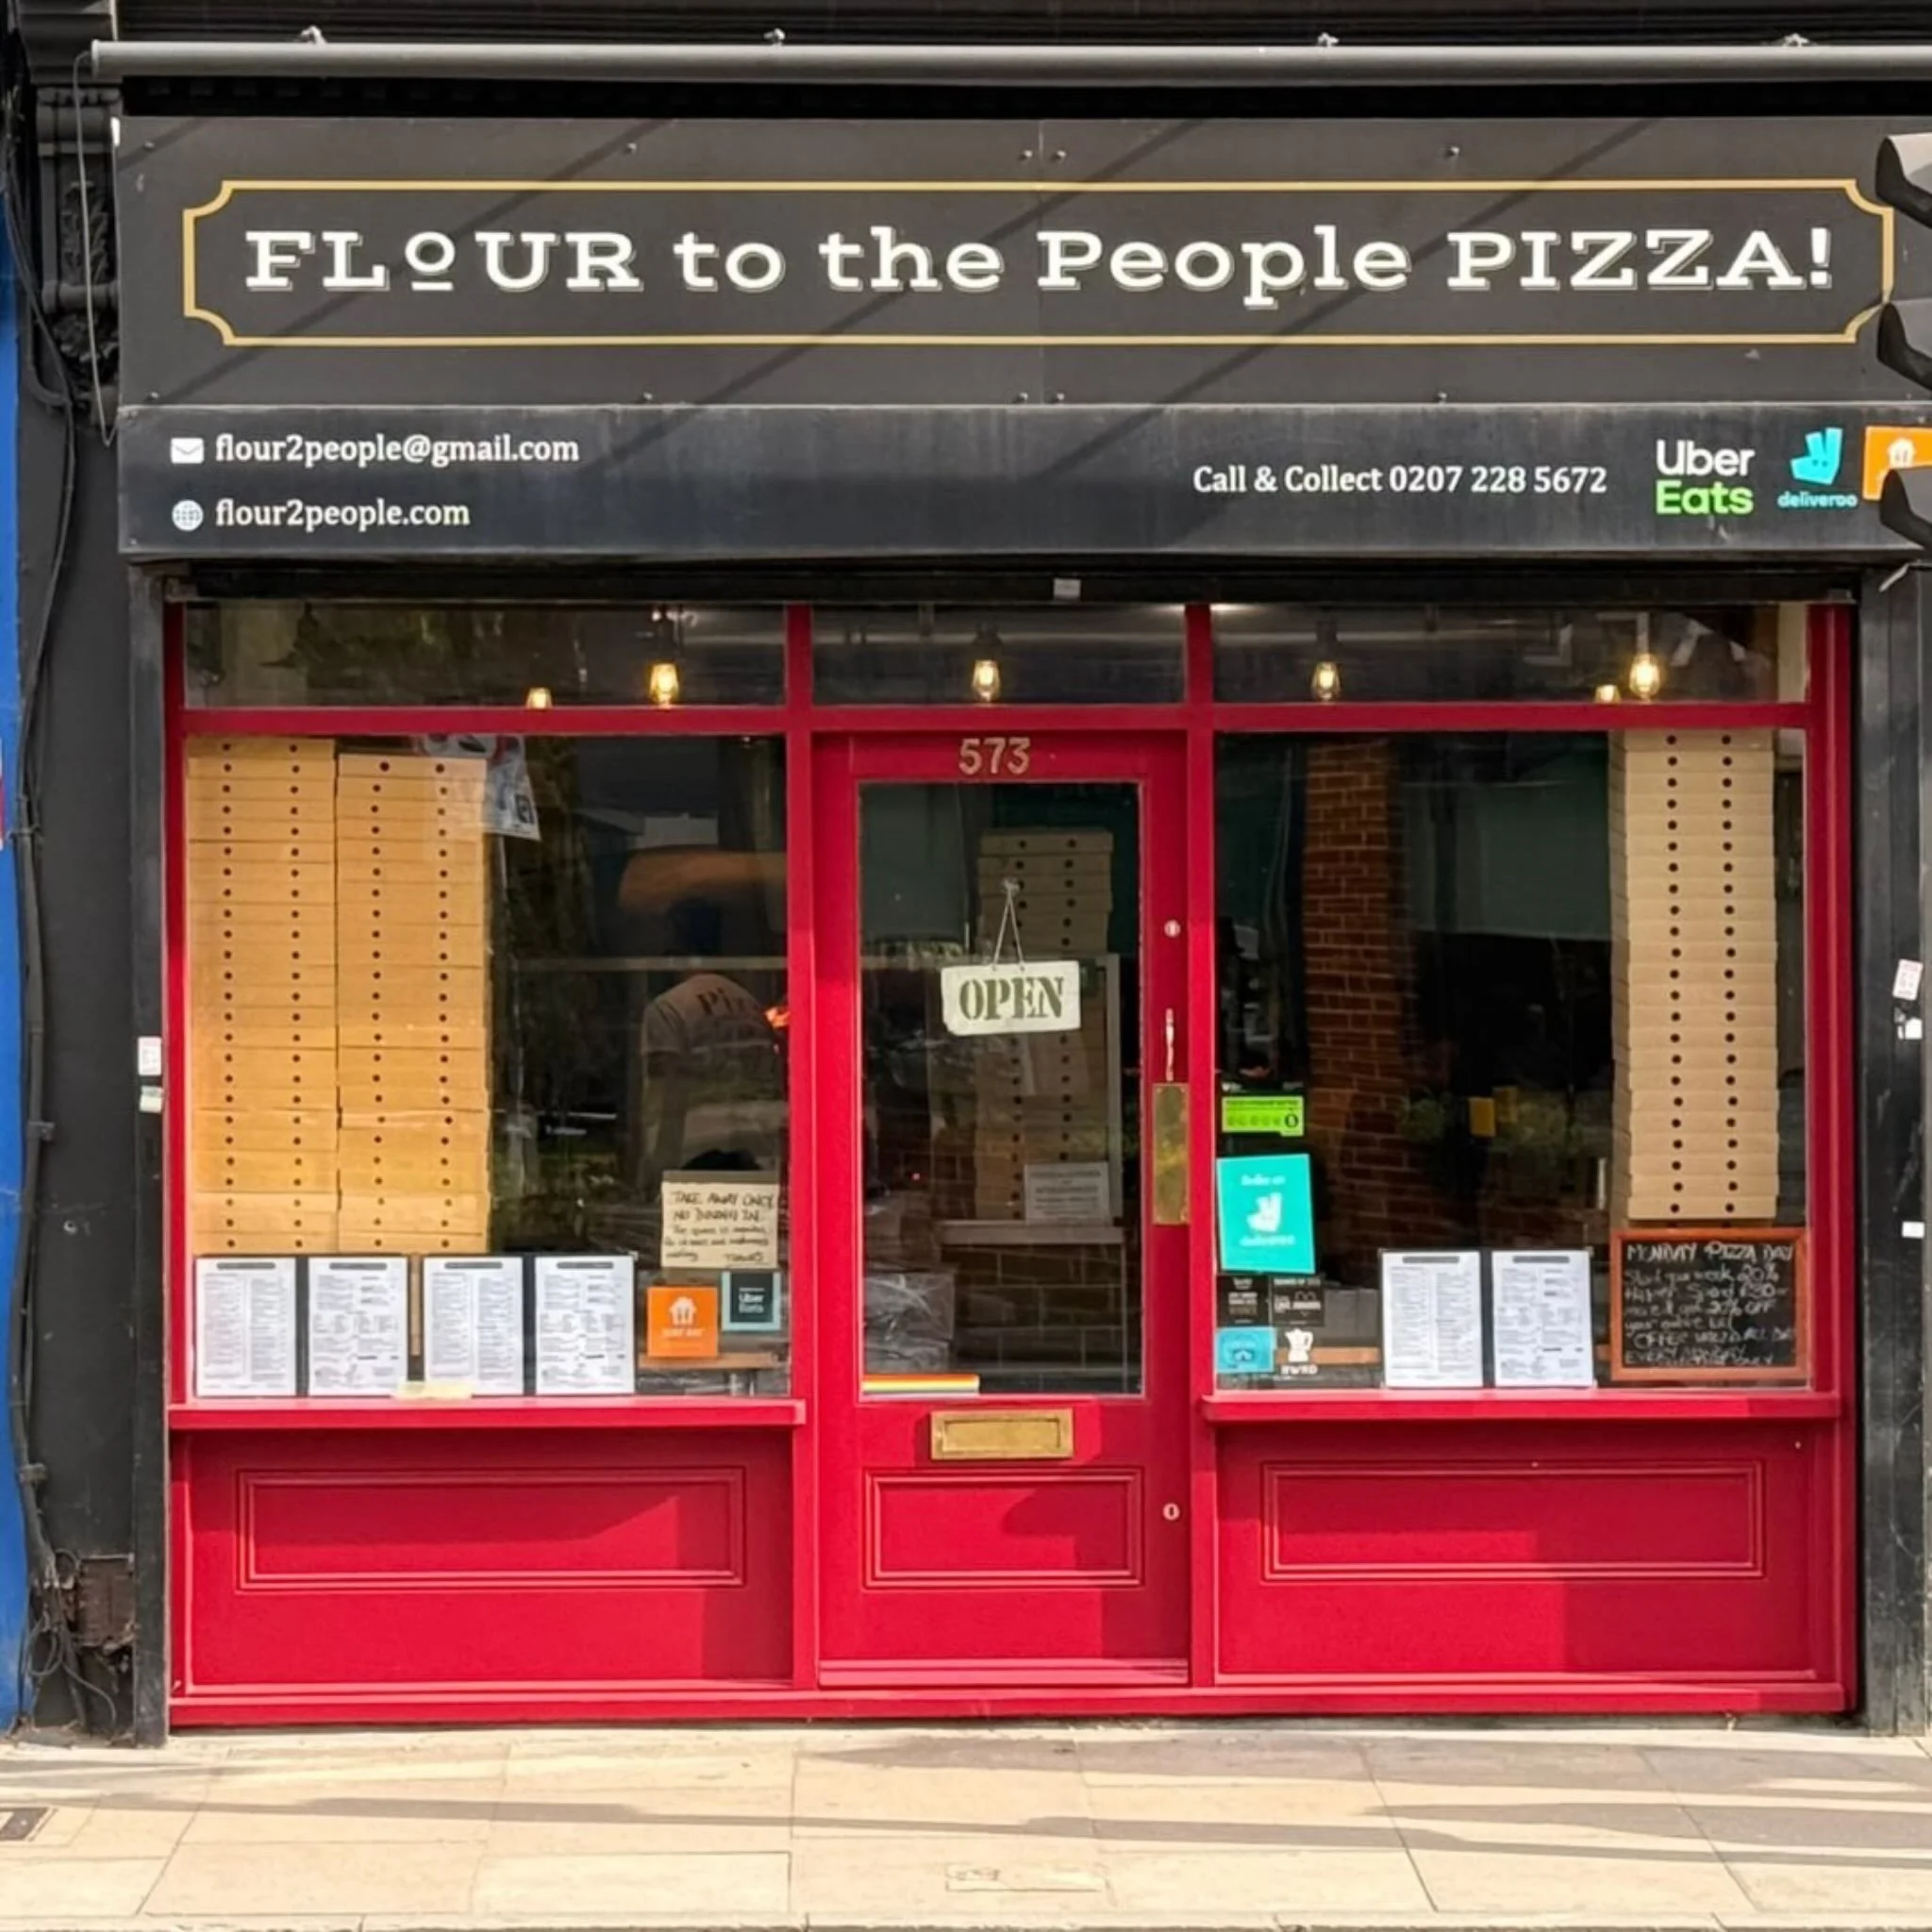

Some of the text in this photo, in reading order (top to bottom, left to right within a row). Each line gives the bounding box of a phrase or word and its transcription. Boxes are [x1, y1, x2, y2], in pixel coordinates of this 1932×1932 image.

[673, 232, 785, 293] to
[819, 225, 1006, 293] the
[1036, 225, 1413, 310] People
[1446, 226, 1835, 292] PIZZA!
[215, 432, 580, 469] flour2people@gmail.com
[1656, 439, 1756, 476] Uber
[1193, 463, 1608, 493] Call & Collect 0207 228 5672
[215, 496, 472, 533] flour2people.com
[1655, 479, 1755, 515] Eats
[1776, 490, 1858, 508] deliveroo
[958, 736, 1031, 775] 573
[958, 975, 1065, 1021] OPEN
[1703, 1241, 1758, 1263] PIZZA
